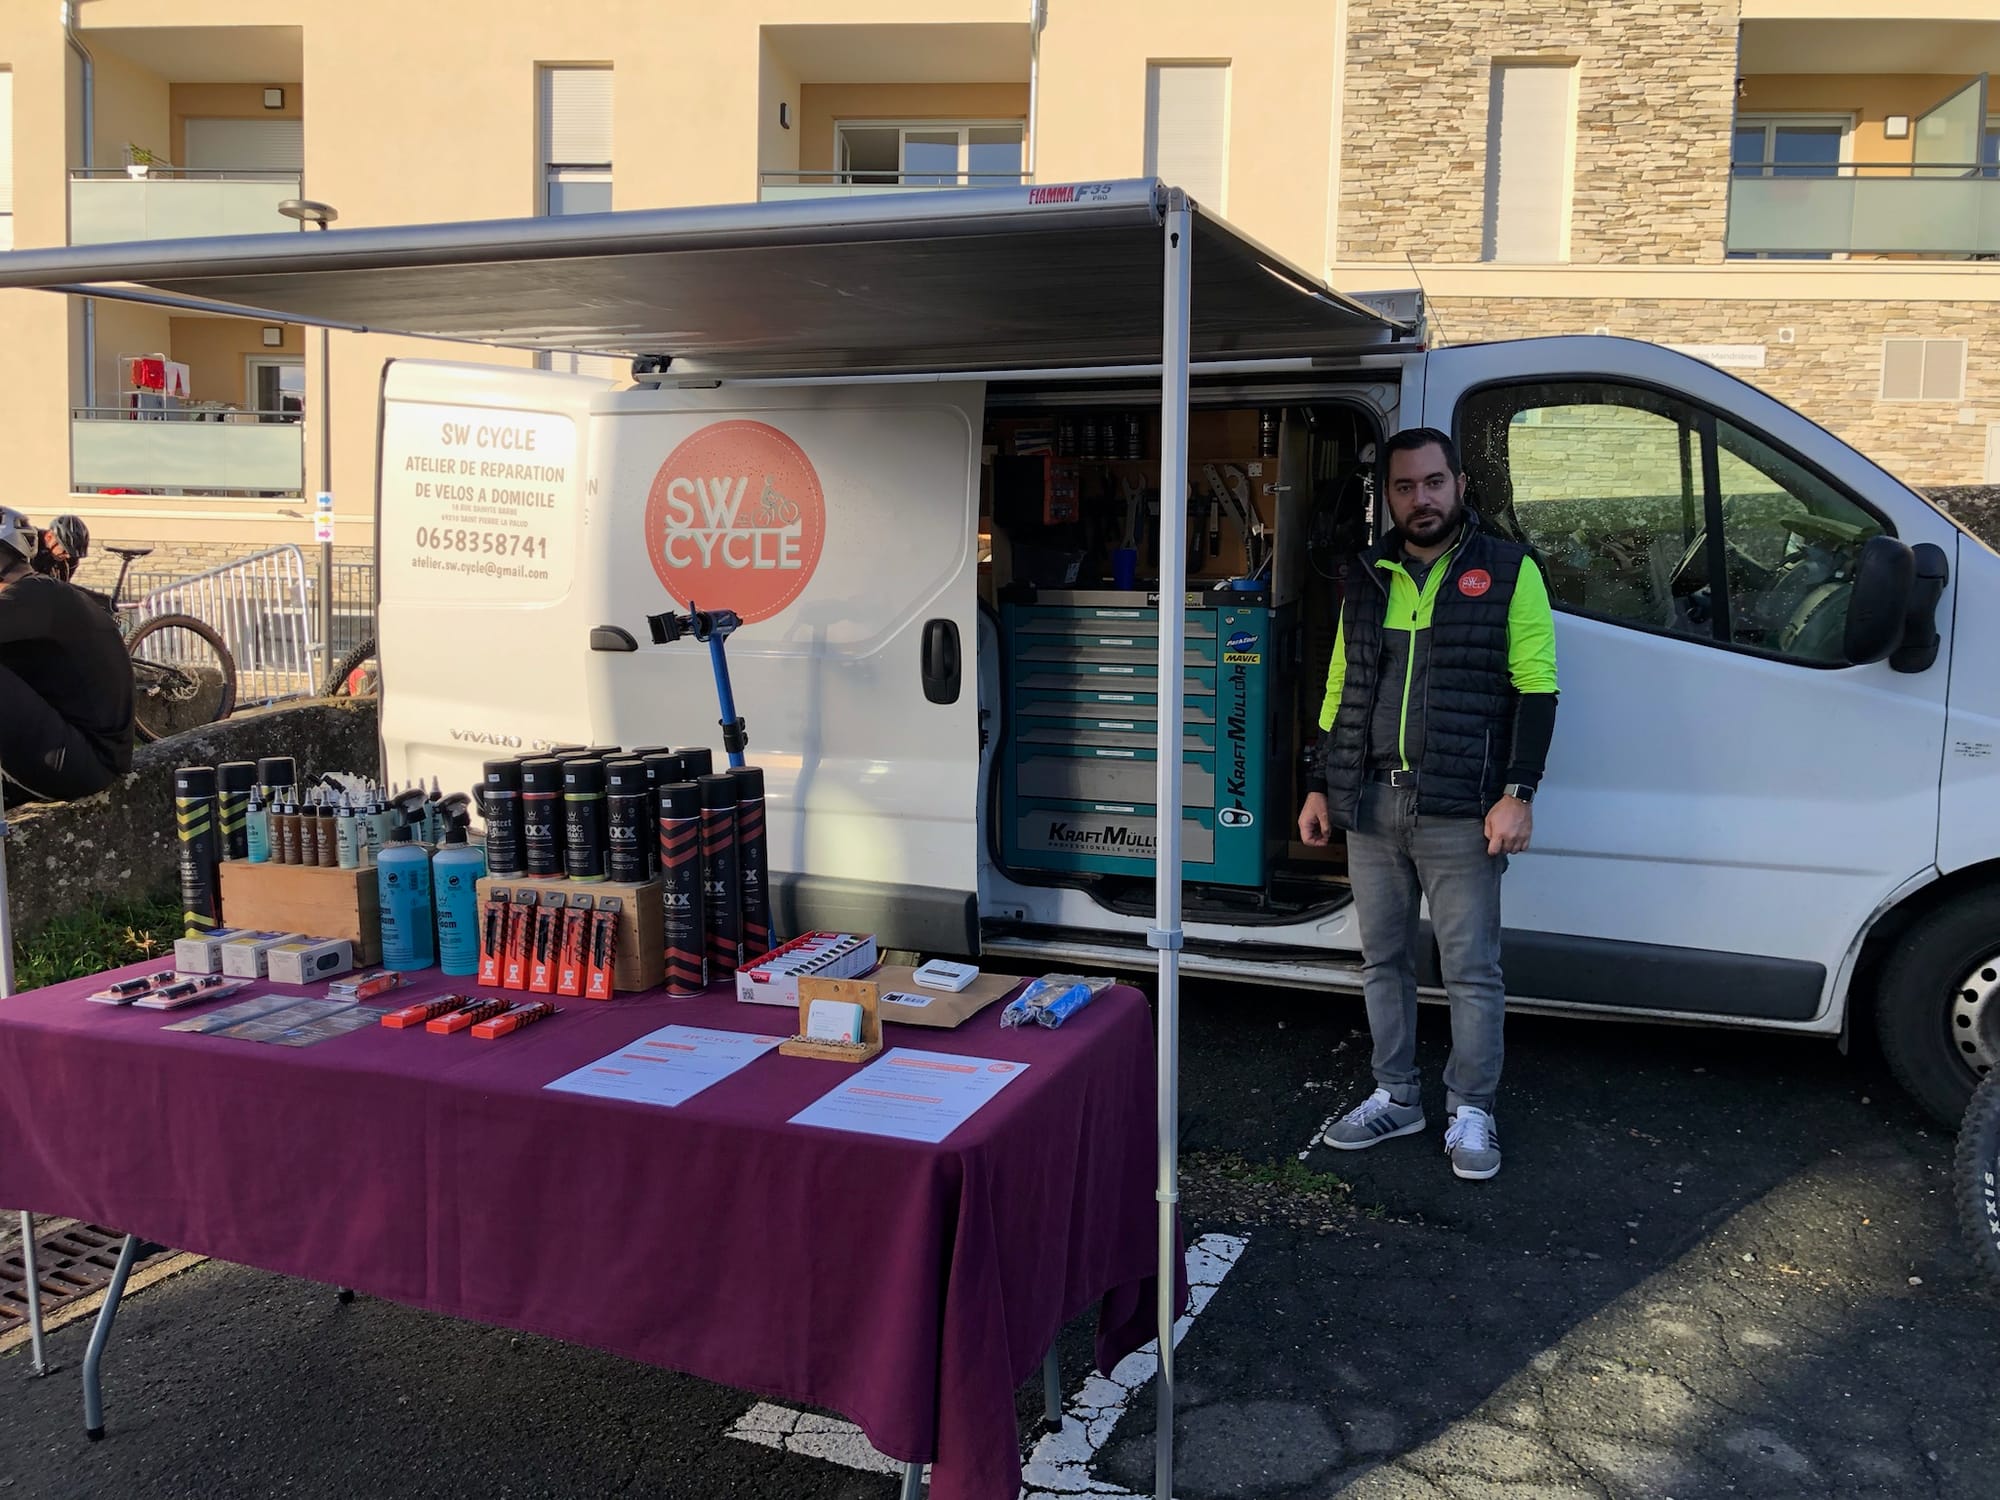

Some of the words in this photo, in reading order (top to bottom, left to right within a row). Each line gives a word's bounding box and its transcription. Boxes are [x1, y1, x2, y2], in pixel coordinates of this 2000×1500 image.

[1028, 186, 1074, 205] FIAMMA
[441, 422, 471, 446] SW
[476, 425, 537, 451] CYCLE
[405, 456, 456, 474] ATELIER
[460, 460, 476, 476] DE
[480, 461, 565, 483] REPARATION
[415, 482, 431, 498] DE
[435, 484, 474, 502] VELOS
[477, 488, 487, 503] A
[491, 489, 555, 509] DOMICILE
[664, 477, 749, 529] SW
[416, 526, 547, 559] 0658358741
[664, 527, 802, 569] CYCLE
[411, 555, 549, 580] atelier.sw.cycle@gmail.com
[1226, 655, 1259, 663] MAVIC
[449, 728, 522, 748] VIVARO
[1048, 822, 1157, 848] KRAFTMÜLL
